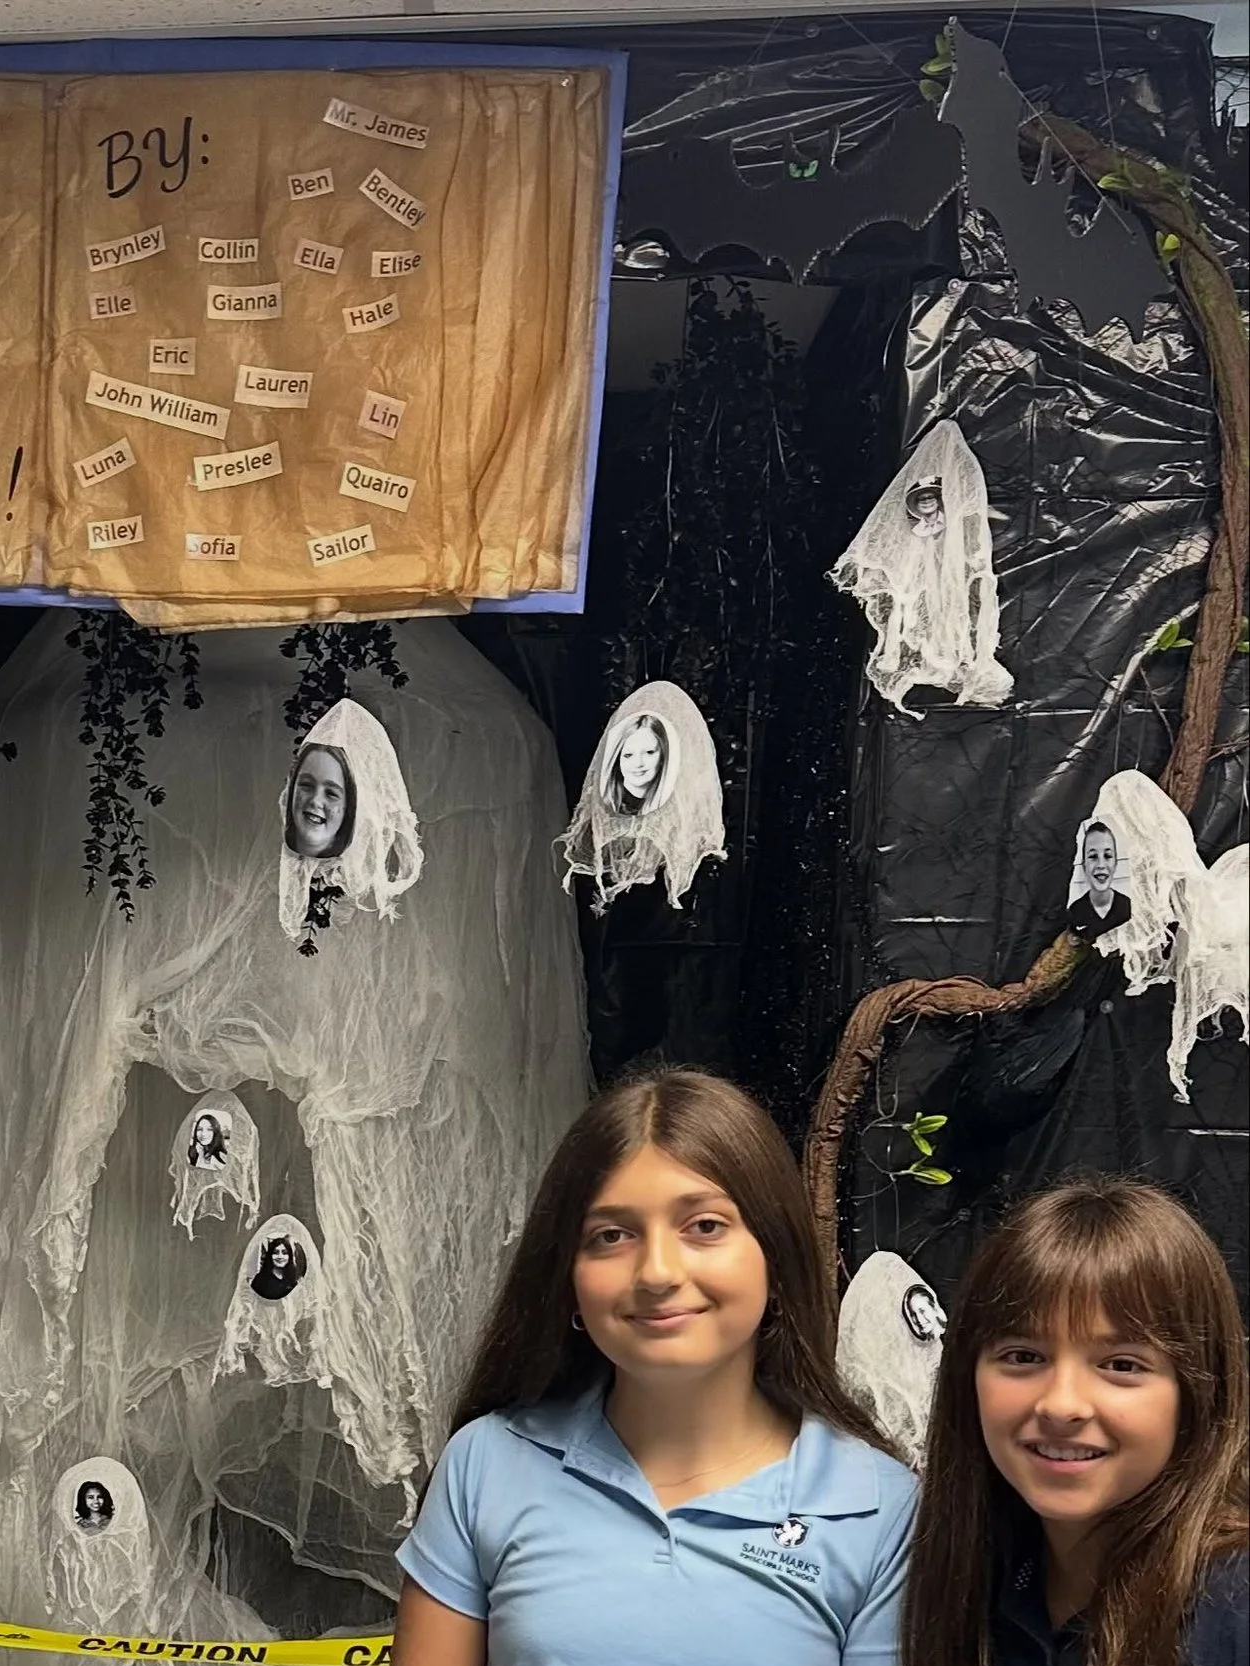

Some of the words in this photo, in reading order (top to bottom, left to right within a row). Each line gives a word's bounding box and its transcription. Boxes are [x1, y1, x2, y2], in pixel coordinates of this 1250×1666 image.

[329, 102, 357, 126] Mr.
[364, 114, 427, 142] James
[98, 116, 210, 199] BY:
[291, 175, 329, 195] Ben
[365, 174, 427, 227] Bentley
[90, 230, 161, 266] Brynley
[200, 241, 255, 259] Collin
[300, 247, 336, 270] Ella
[379, 253, 422, 275] Elise
[95, 295, 132, 315] Elle
[212, 293, 277, 312] Gianna
[350, 302, 393, 326] Hale
[152, 345, 189, 364] Eric
[245, 371, 309, 394] Lauren
[94, 381, 142, 409] John
[150, 393, 218, 427] William
[369, 402, 399, 430] Lin
[80, 447, 127, 480] Luna
[202, 448, 274, 482] Preslee
[345, 465, 410, 500] Quairo
[92, 521, 138, 544] Riley
[313, 532, 369, 562] Sailor
[741, 1542, 778, 1560] SAINT
[77, 1637, 268, 1664] CAUTION
